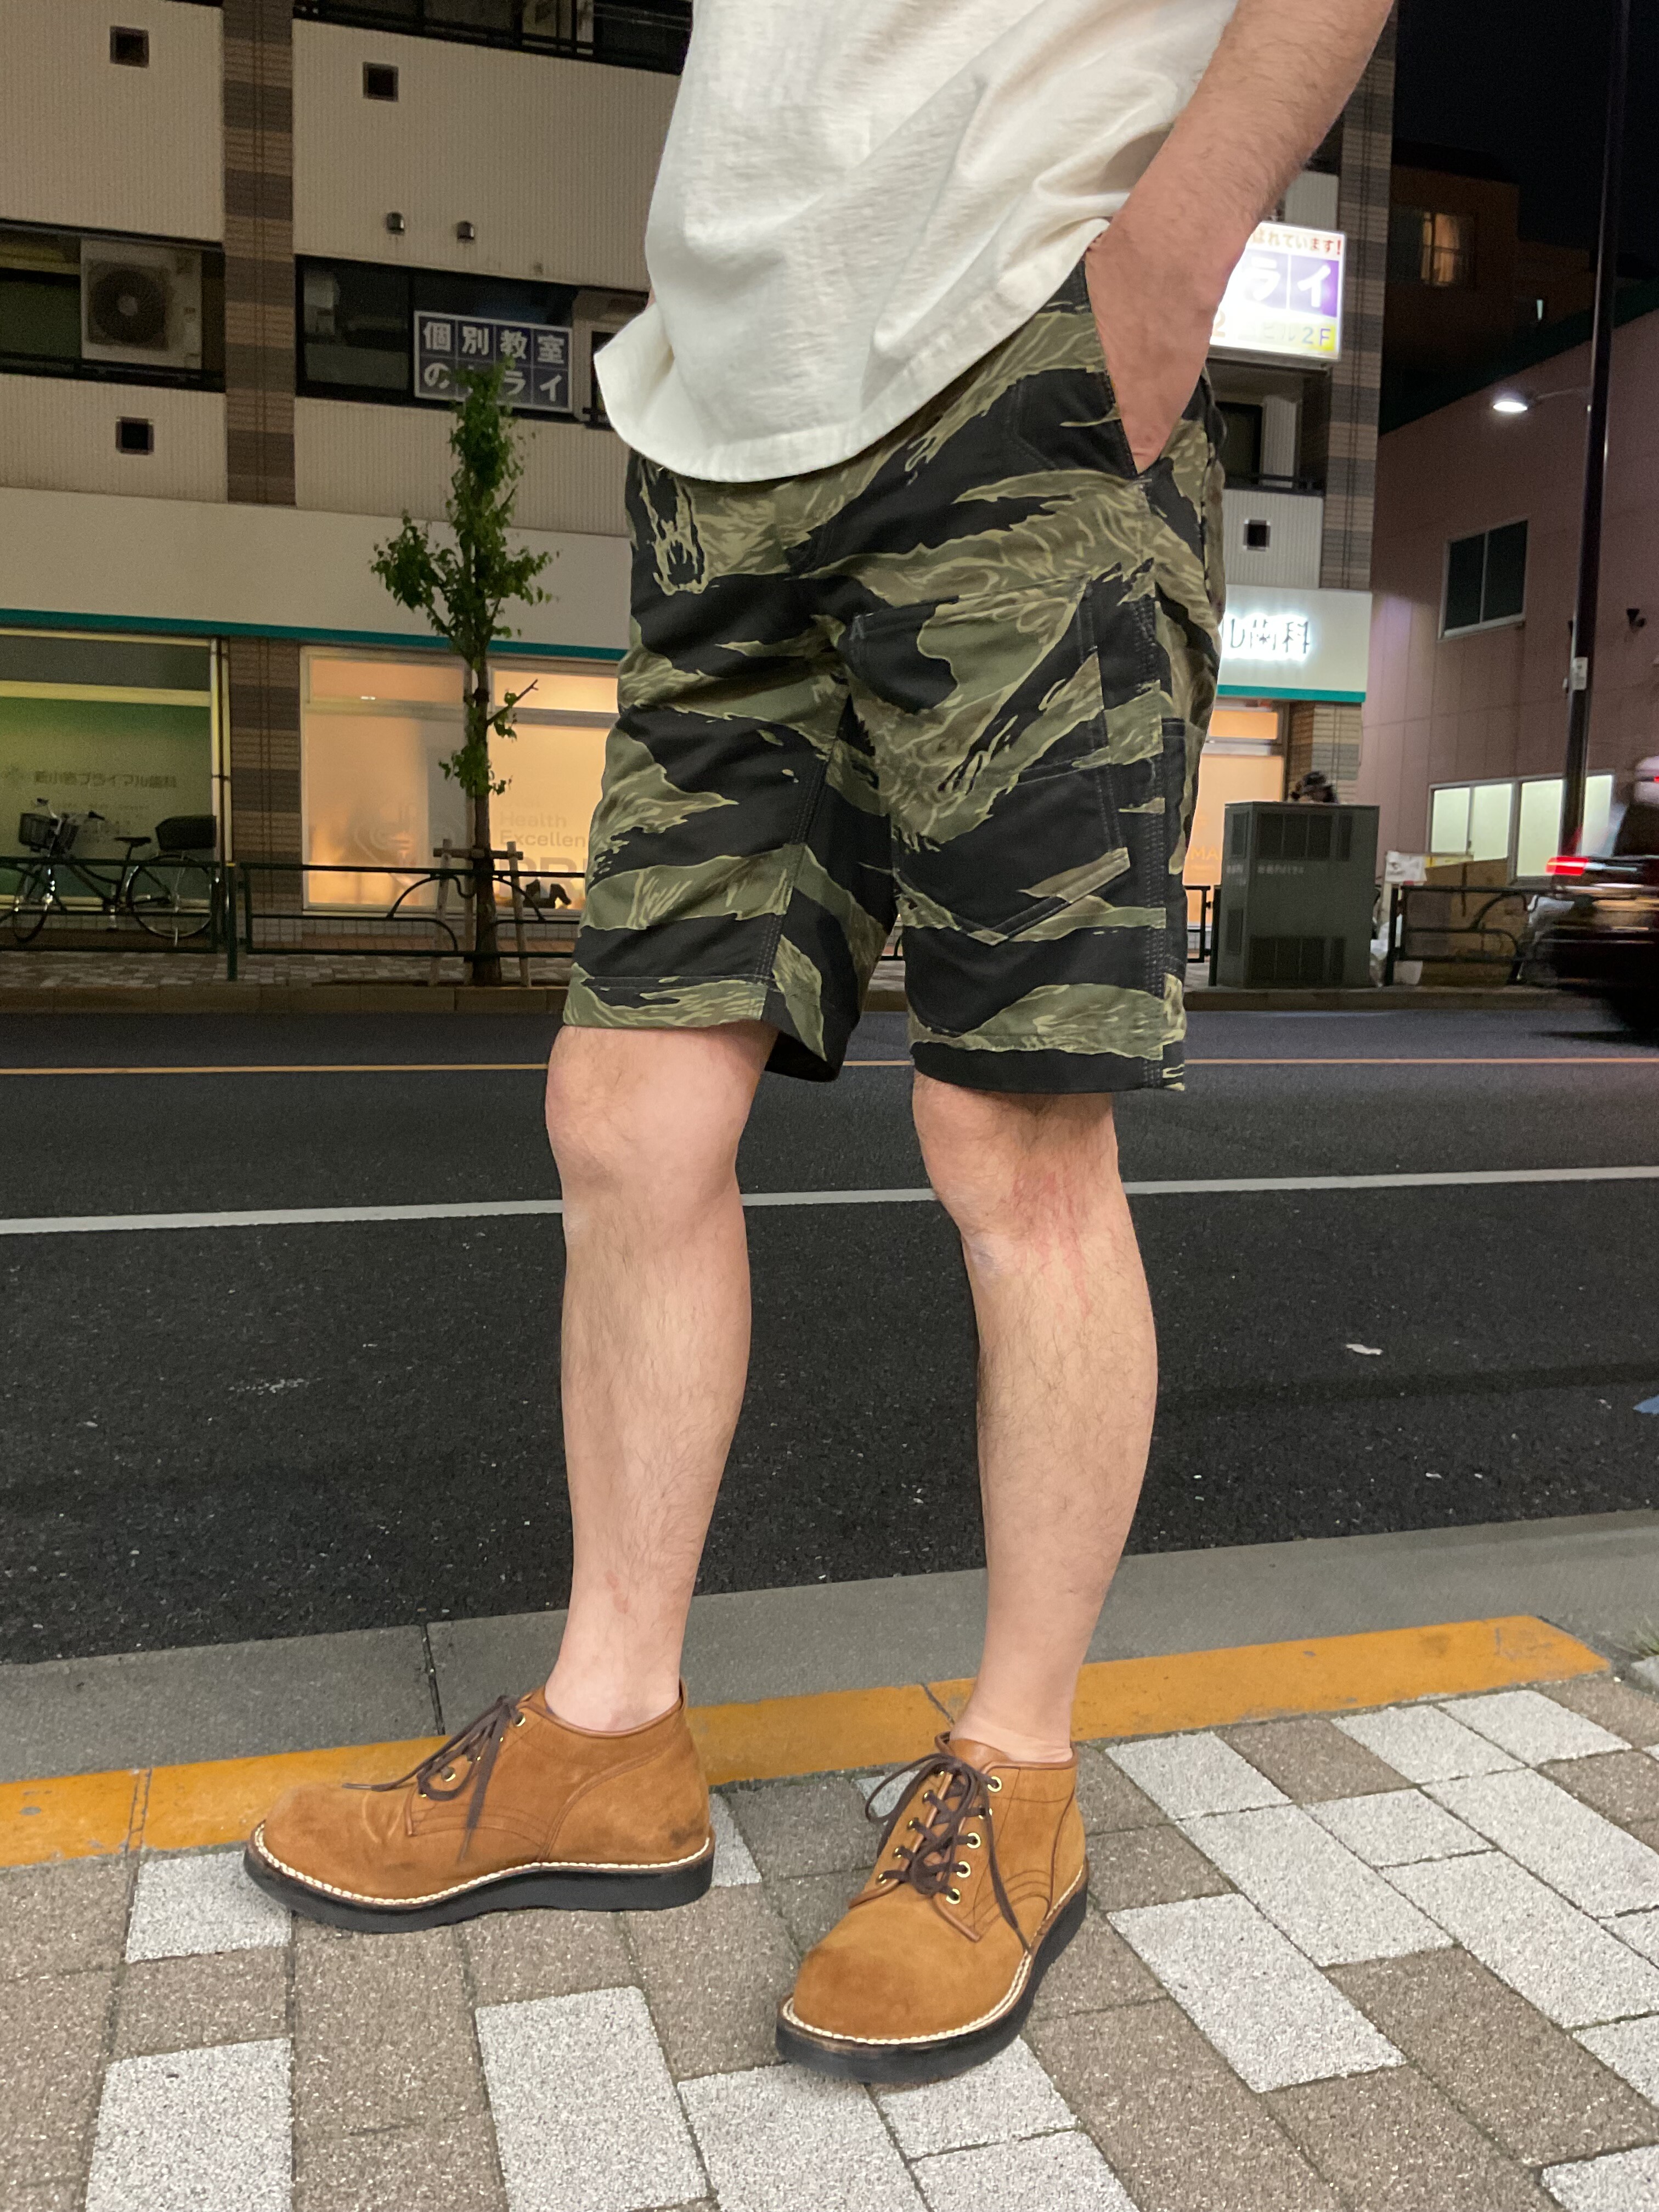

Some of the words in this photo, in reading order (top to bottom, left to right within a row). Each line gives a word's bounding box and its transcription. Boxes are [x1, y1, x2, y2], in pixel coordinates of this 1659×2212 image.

[423, 321, 565, 364] 個別教室
[424, 362, 562, 402] のライ
[500, 811, 567, 828] Health
